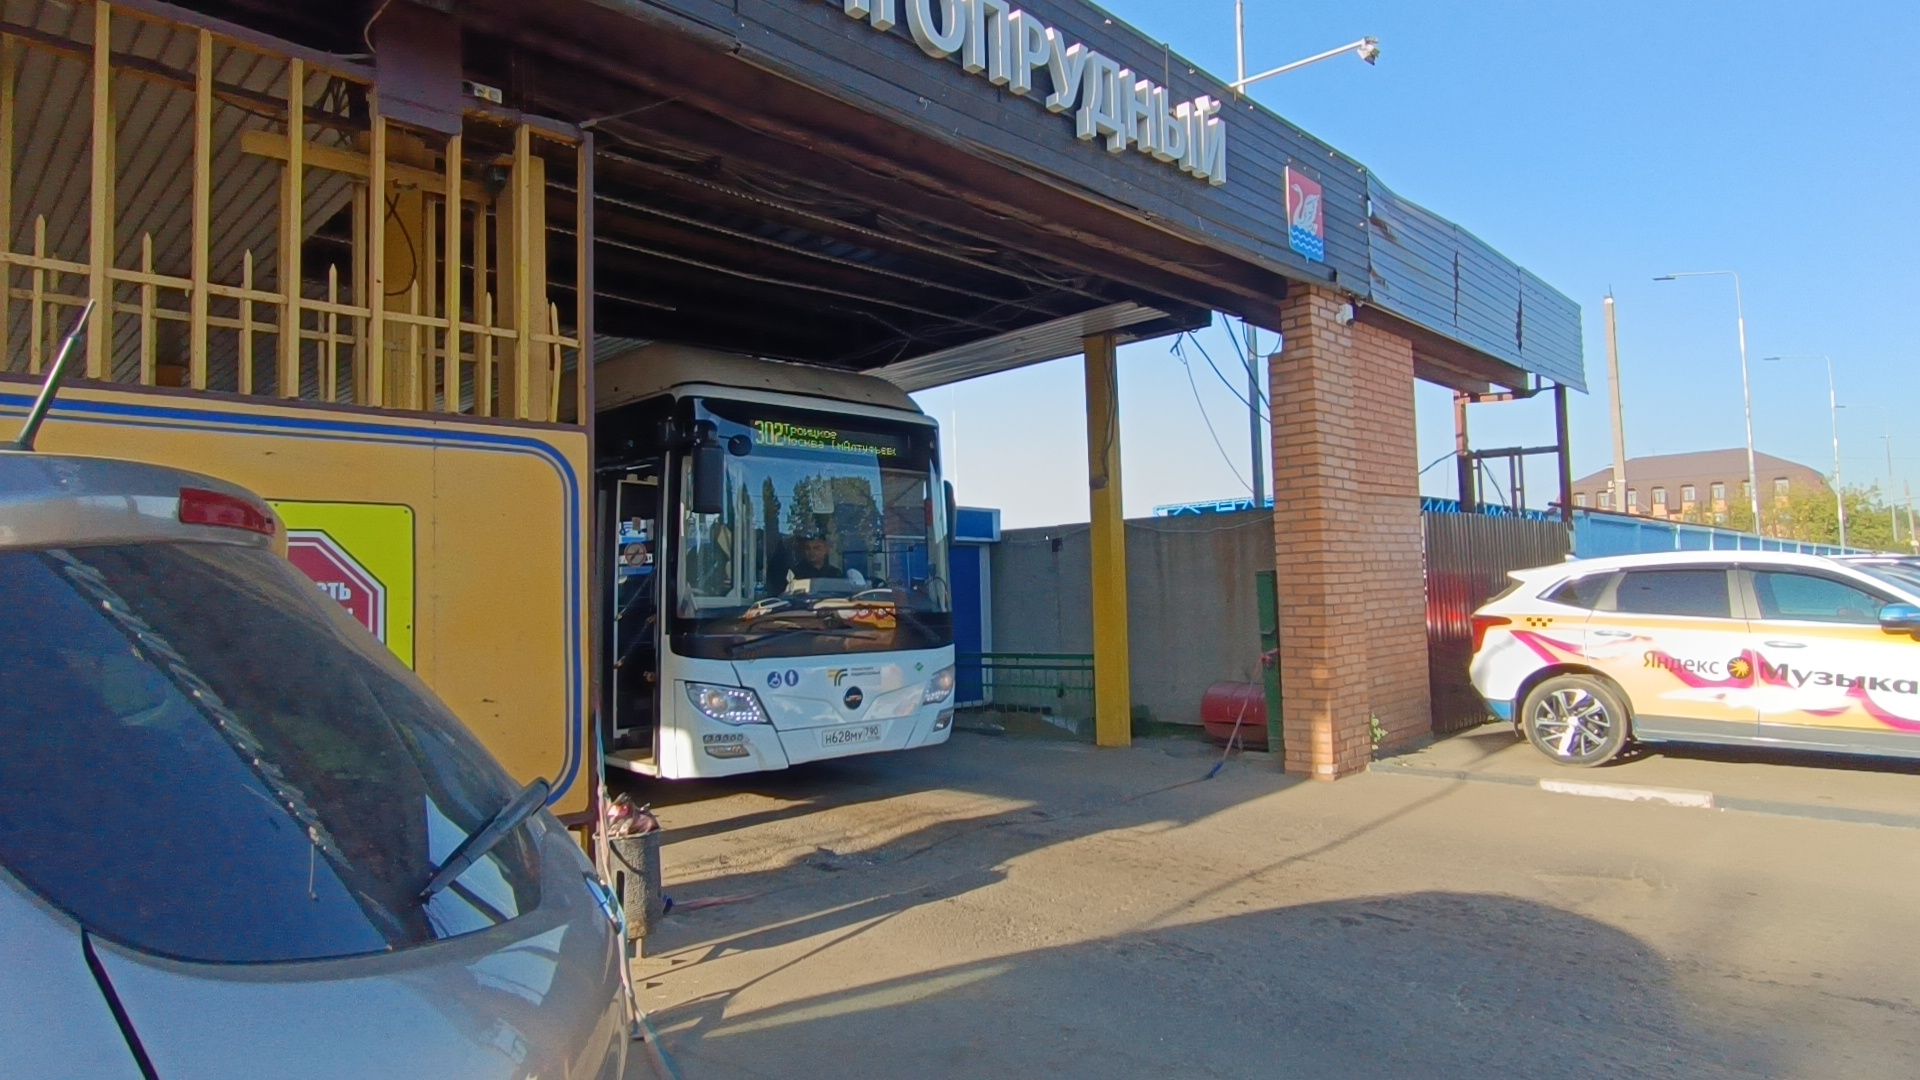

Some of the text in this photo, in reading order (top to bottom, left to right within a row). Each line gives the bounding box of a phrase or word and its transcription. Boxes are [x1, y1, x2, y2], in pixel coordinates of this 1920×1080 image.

[754, 420, 784, 447] 302
[784, 434, 825, 449] Москва
[1643, 650, 1918, 695] Яндекс Музыка
